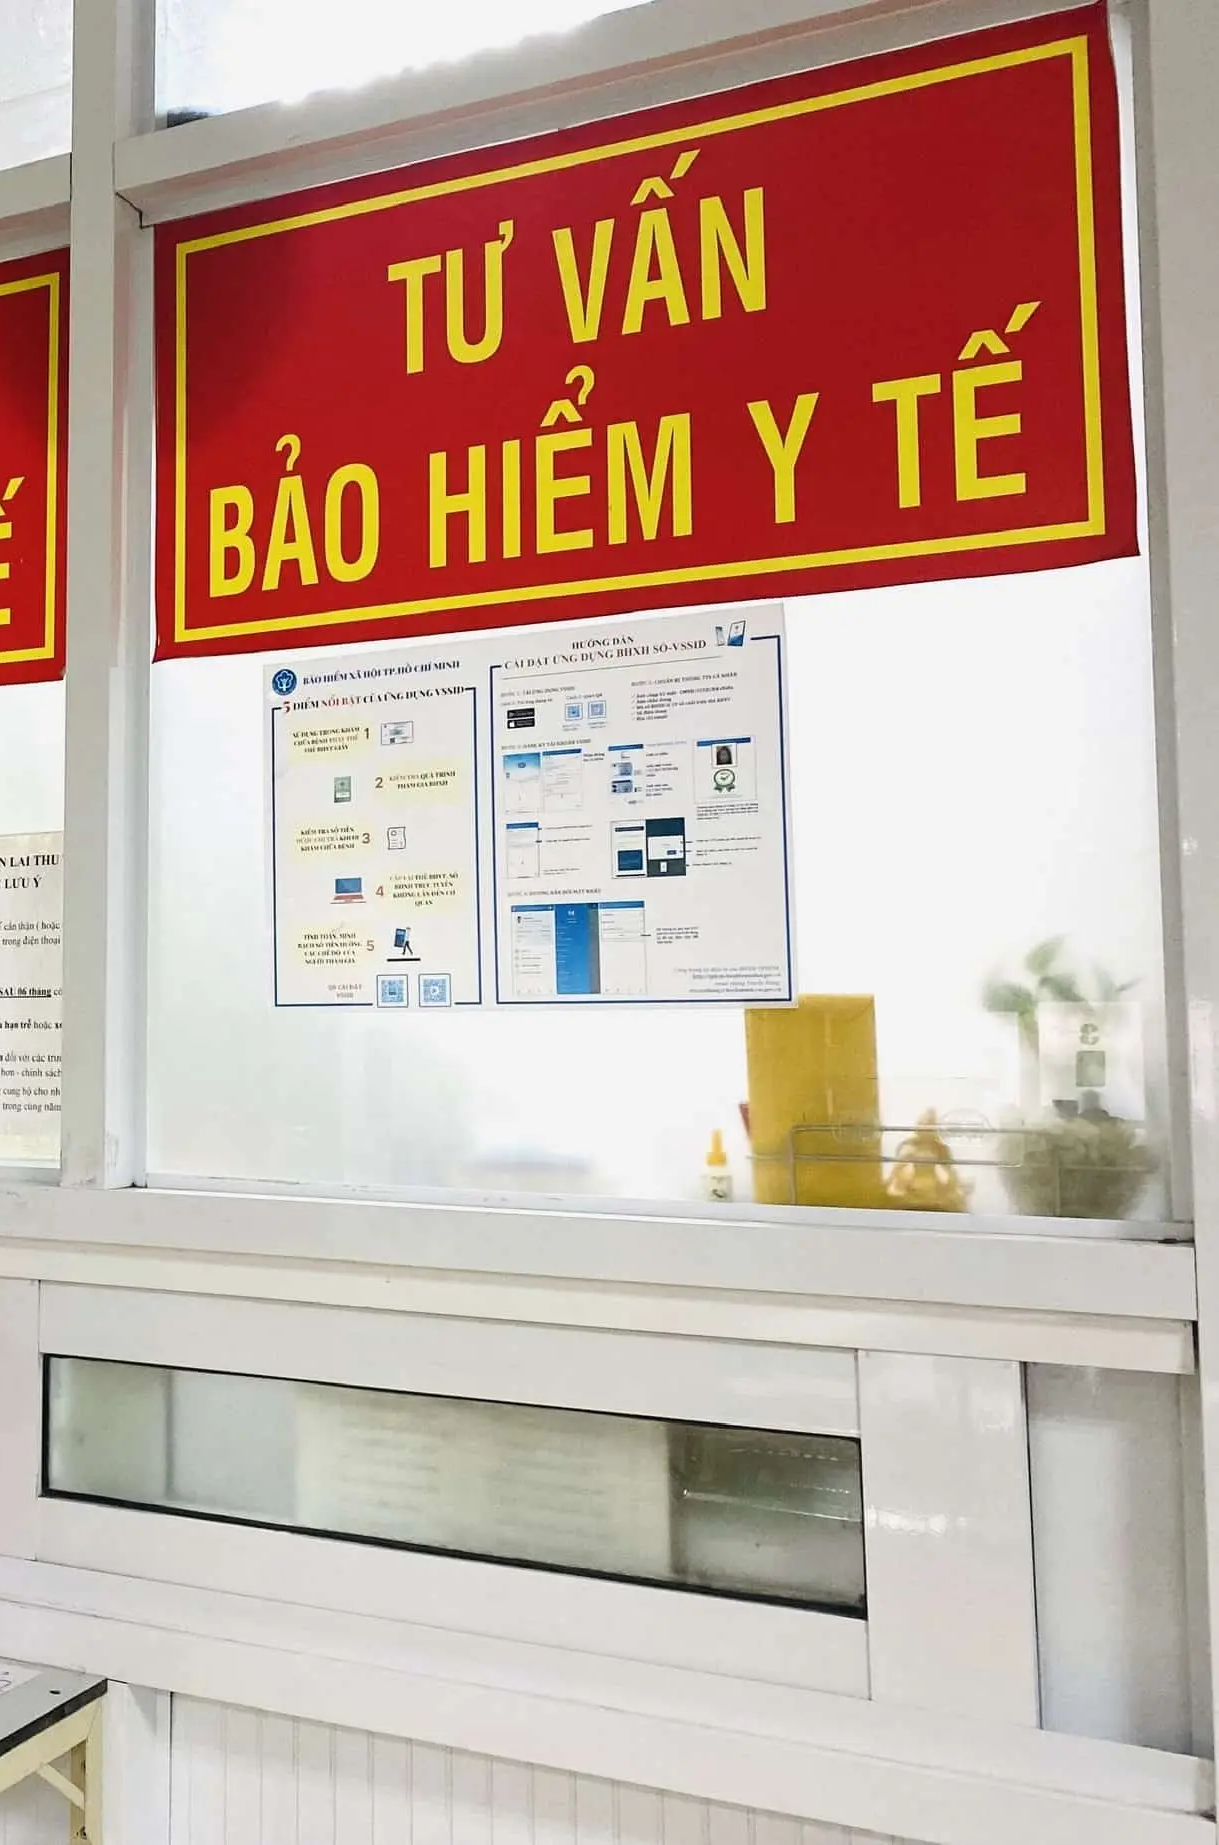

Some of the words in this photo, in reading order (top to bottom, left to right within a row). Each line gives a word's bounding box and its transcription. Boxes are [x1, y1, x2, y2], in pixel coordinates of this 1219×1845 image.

[388, 219, 513, 375] TƯ
[552, 148, 769, 344] VẤN
[208, 434, 380, 598] BẢO
[429, 364, 694, 569] HIỂM
[747, 392, 819, 524] Y
[872, 300, 1041, 510] TẾ
[283, 701, 290, 713] 5
[364, 728, 369, 739] 1
[375, 777, 383, 788] 2
[362, 833, 370, 844] 3
[10, 856, 30, 867] LAI
[34, 854, 59, 866] THU
[376, 886, 384, 896] 4
[367, 940, 374, 951] 5
